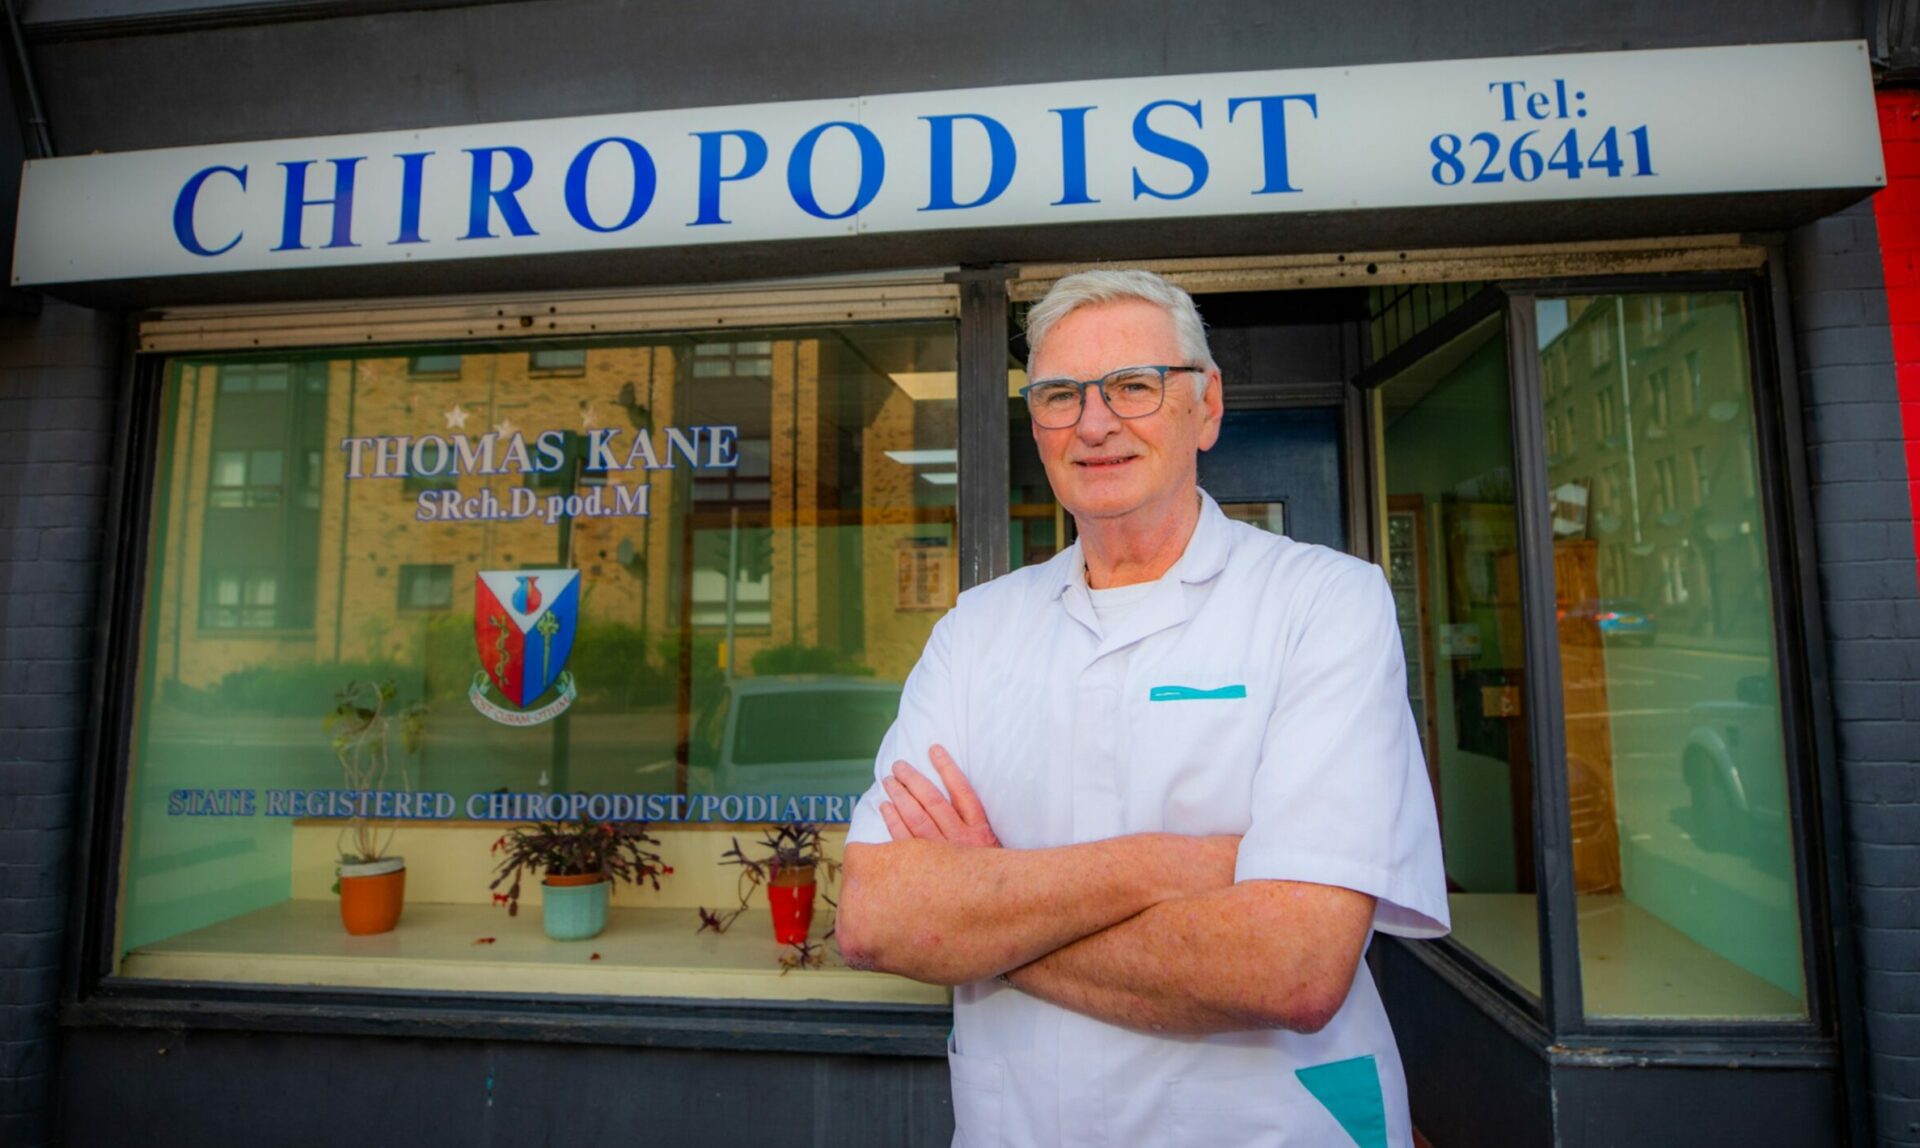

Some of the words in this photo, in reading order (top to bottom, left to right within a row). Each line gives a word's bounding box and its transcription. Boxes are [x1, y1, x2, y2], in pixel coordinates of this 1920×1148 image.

[1488, 79, 1587, 122] Tel:
[172, 93, 1318, 257] CHIROPODIST
[1430, 124, 1660, 187] 826441
[341, 429, 566, 479] THOMAS
[585, 425, 740, 472] KANE
[415, 484, 650, 525] SRch.D.pod.M
[167, 789, 256, 817] STATE
[264, 789, 456, 819] REGISTERED
[464, 792, 859, 824] CHIROPODIST/PODIATRI
